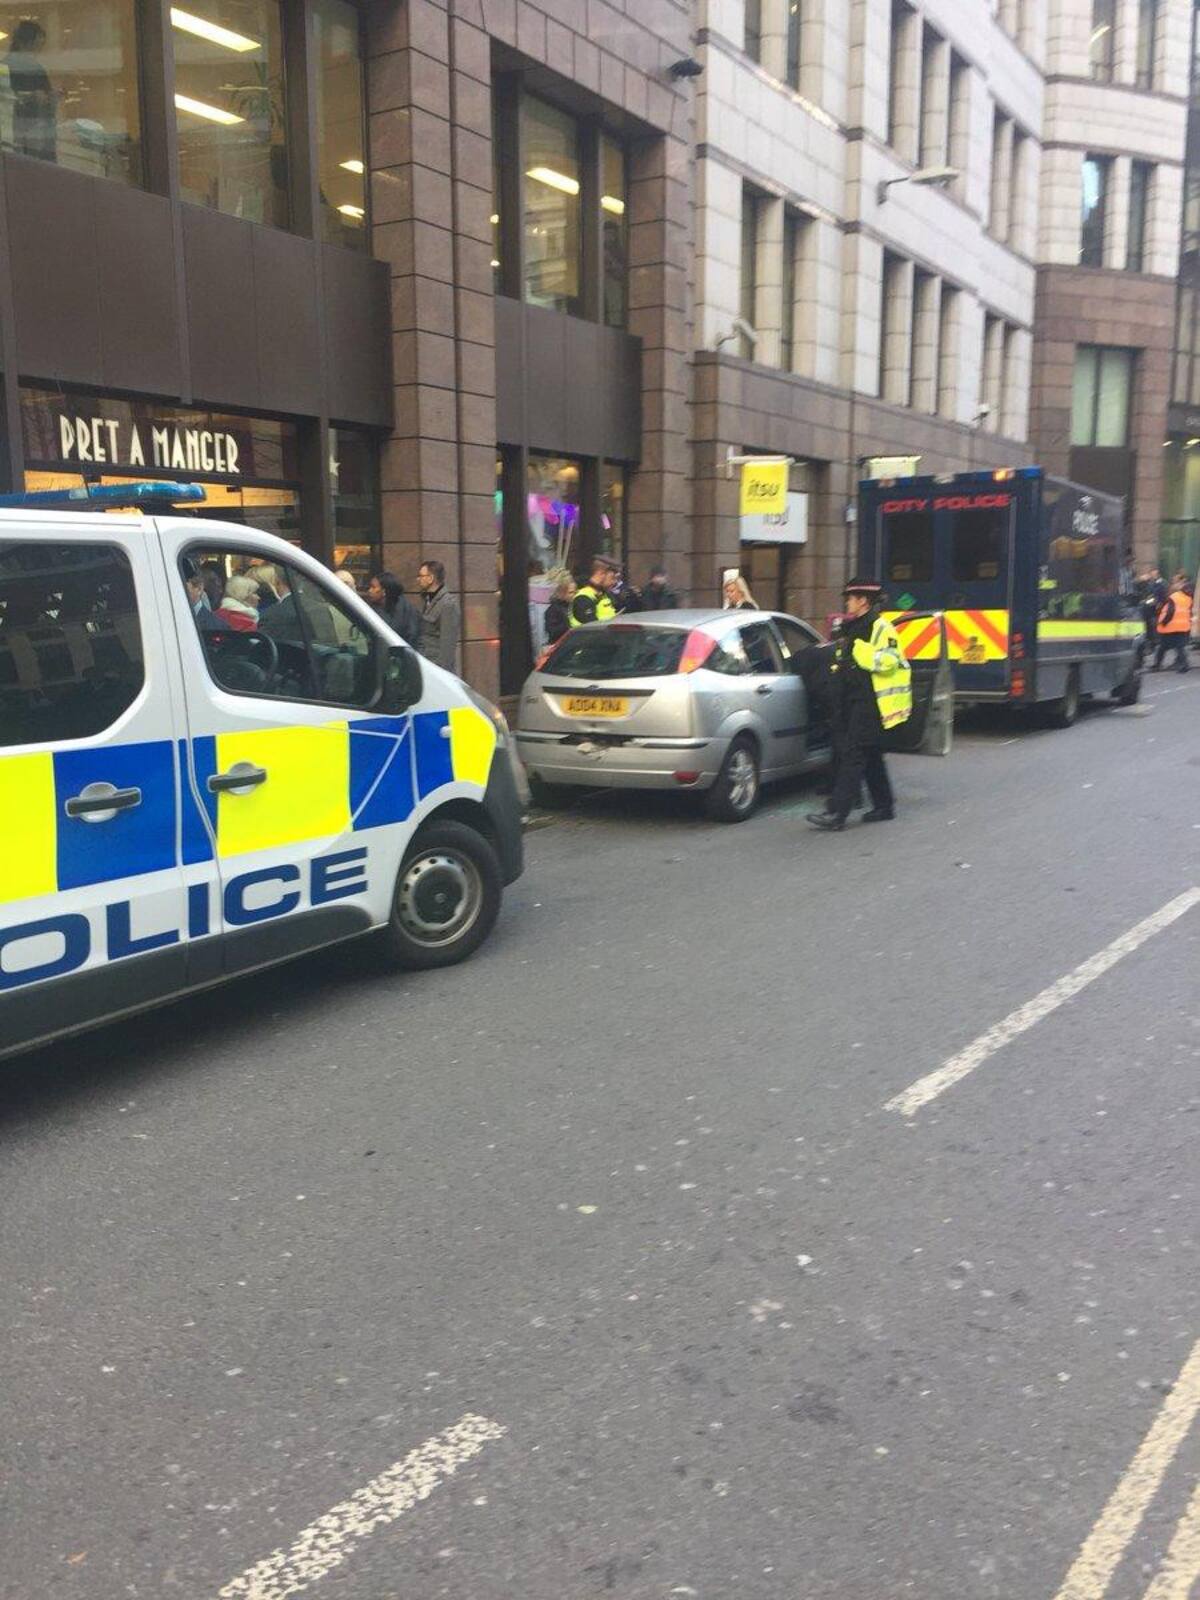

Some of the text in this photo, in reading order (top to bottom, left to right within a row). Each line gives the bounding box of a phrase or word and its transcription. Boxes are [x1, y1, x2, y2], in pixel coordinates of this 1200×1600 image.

[59, 414, 241, 474] PRET A MANGER
[747, 479, 780, 498] itsu
[882, 494, 1010, 513] CITY POLICE
